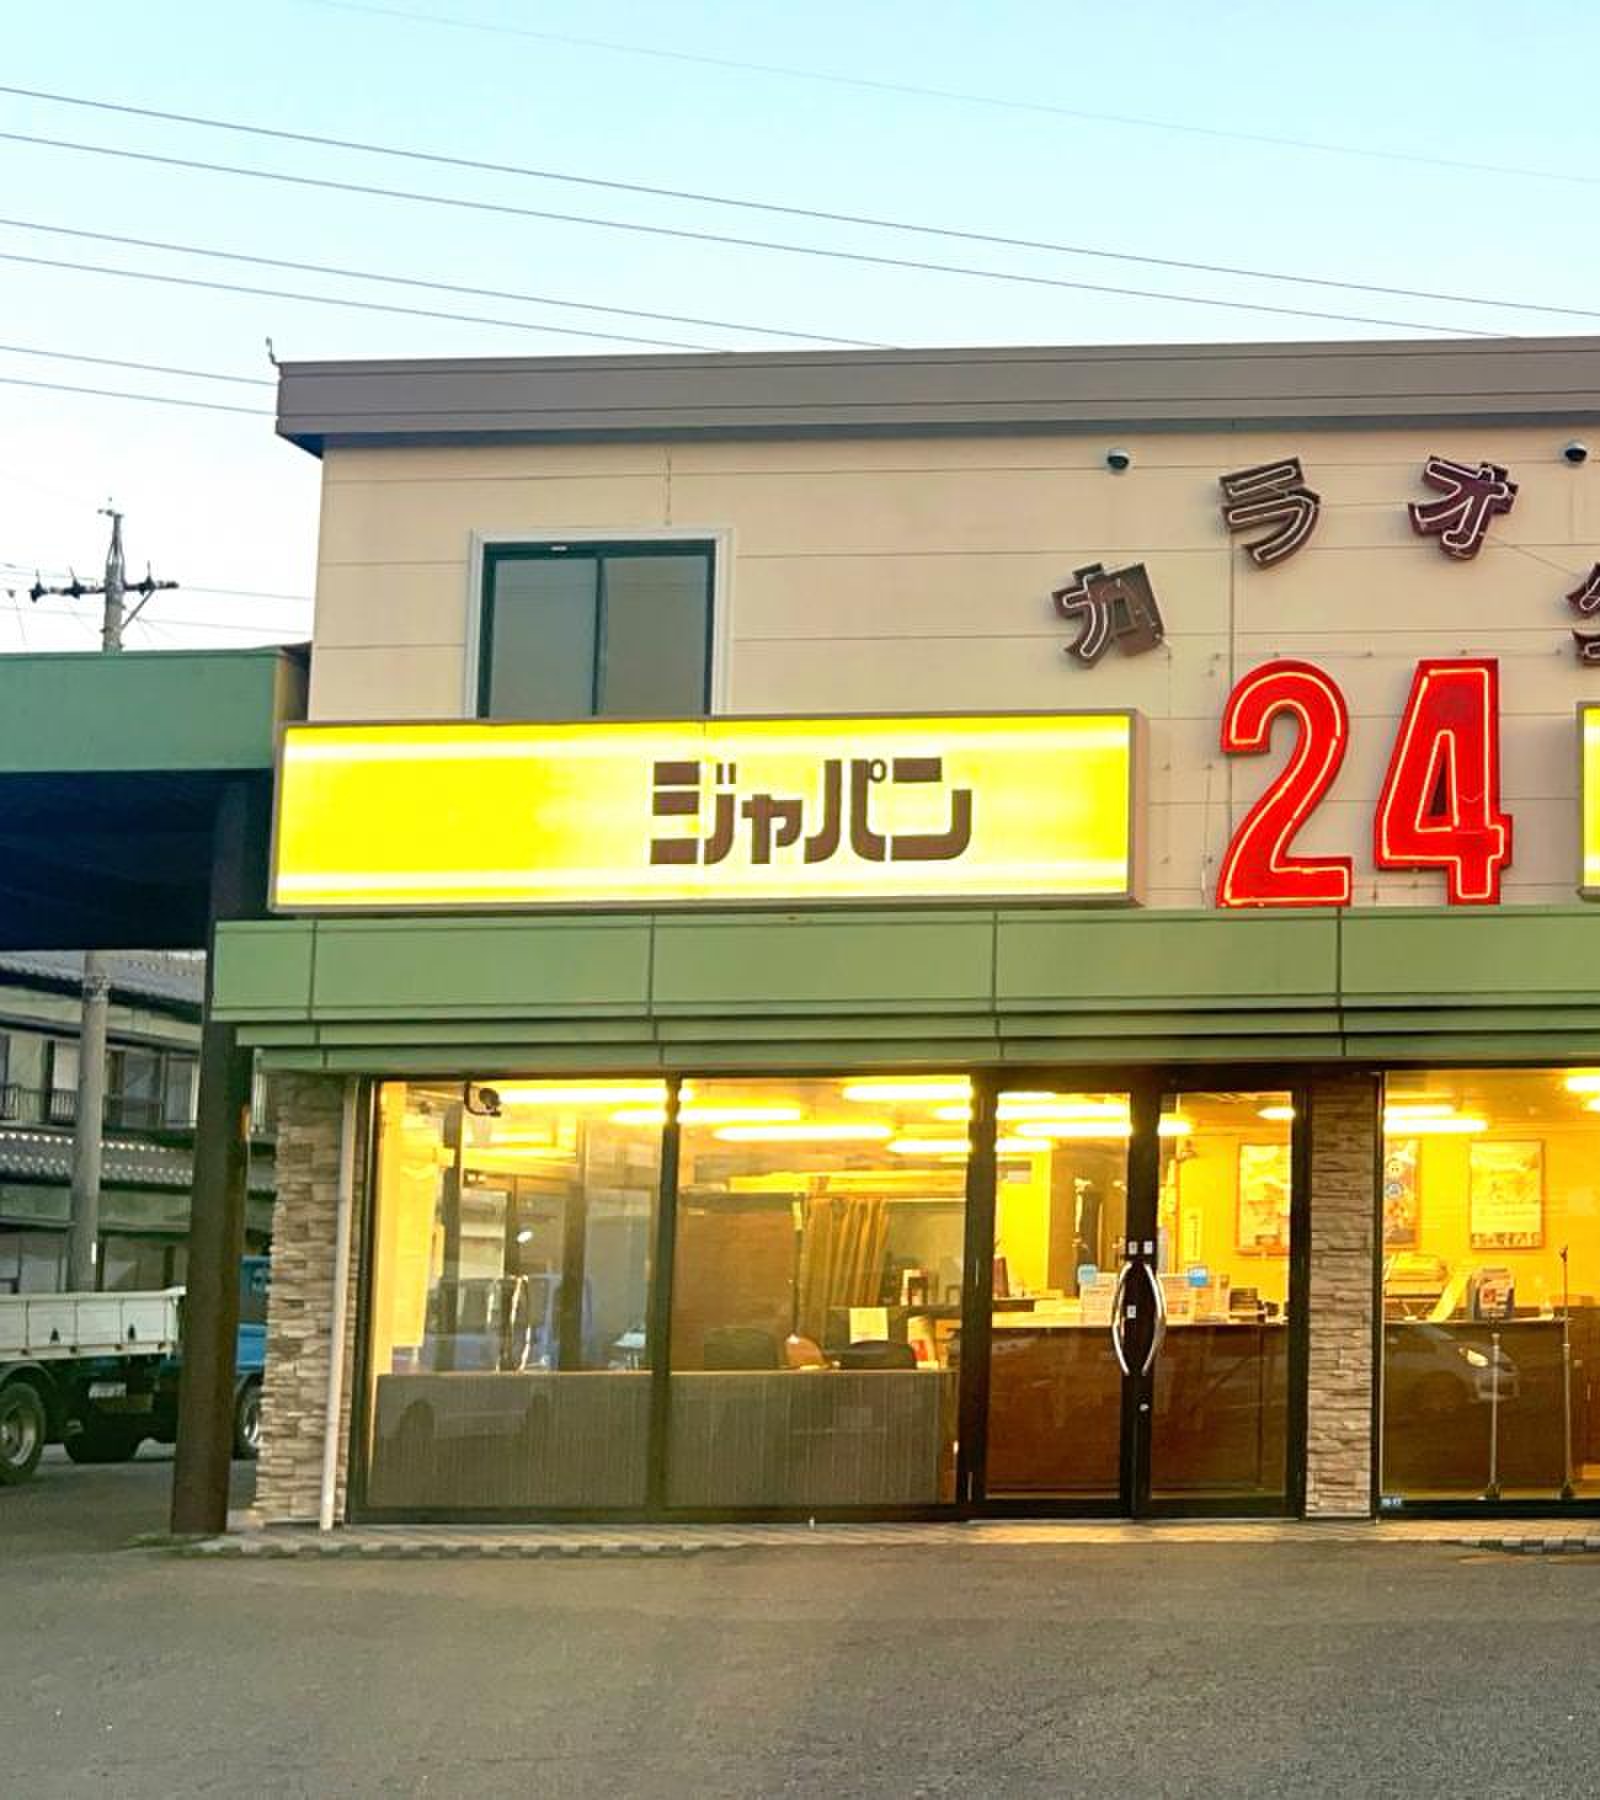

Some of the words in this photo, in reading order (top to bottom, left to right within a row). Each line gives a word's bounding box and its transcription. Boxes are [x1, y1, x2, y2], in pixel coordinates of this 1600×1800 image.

[650, 757, 972, 865] ジャパン
[1216, 657, 1514, 907] 24
